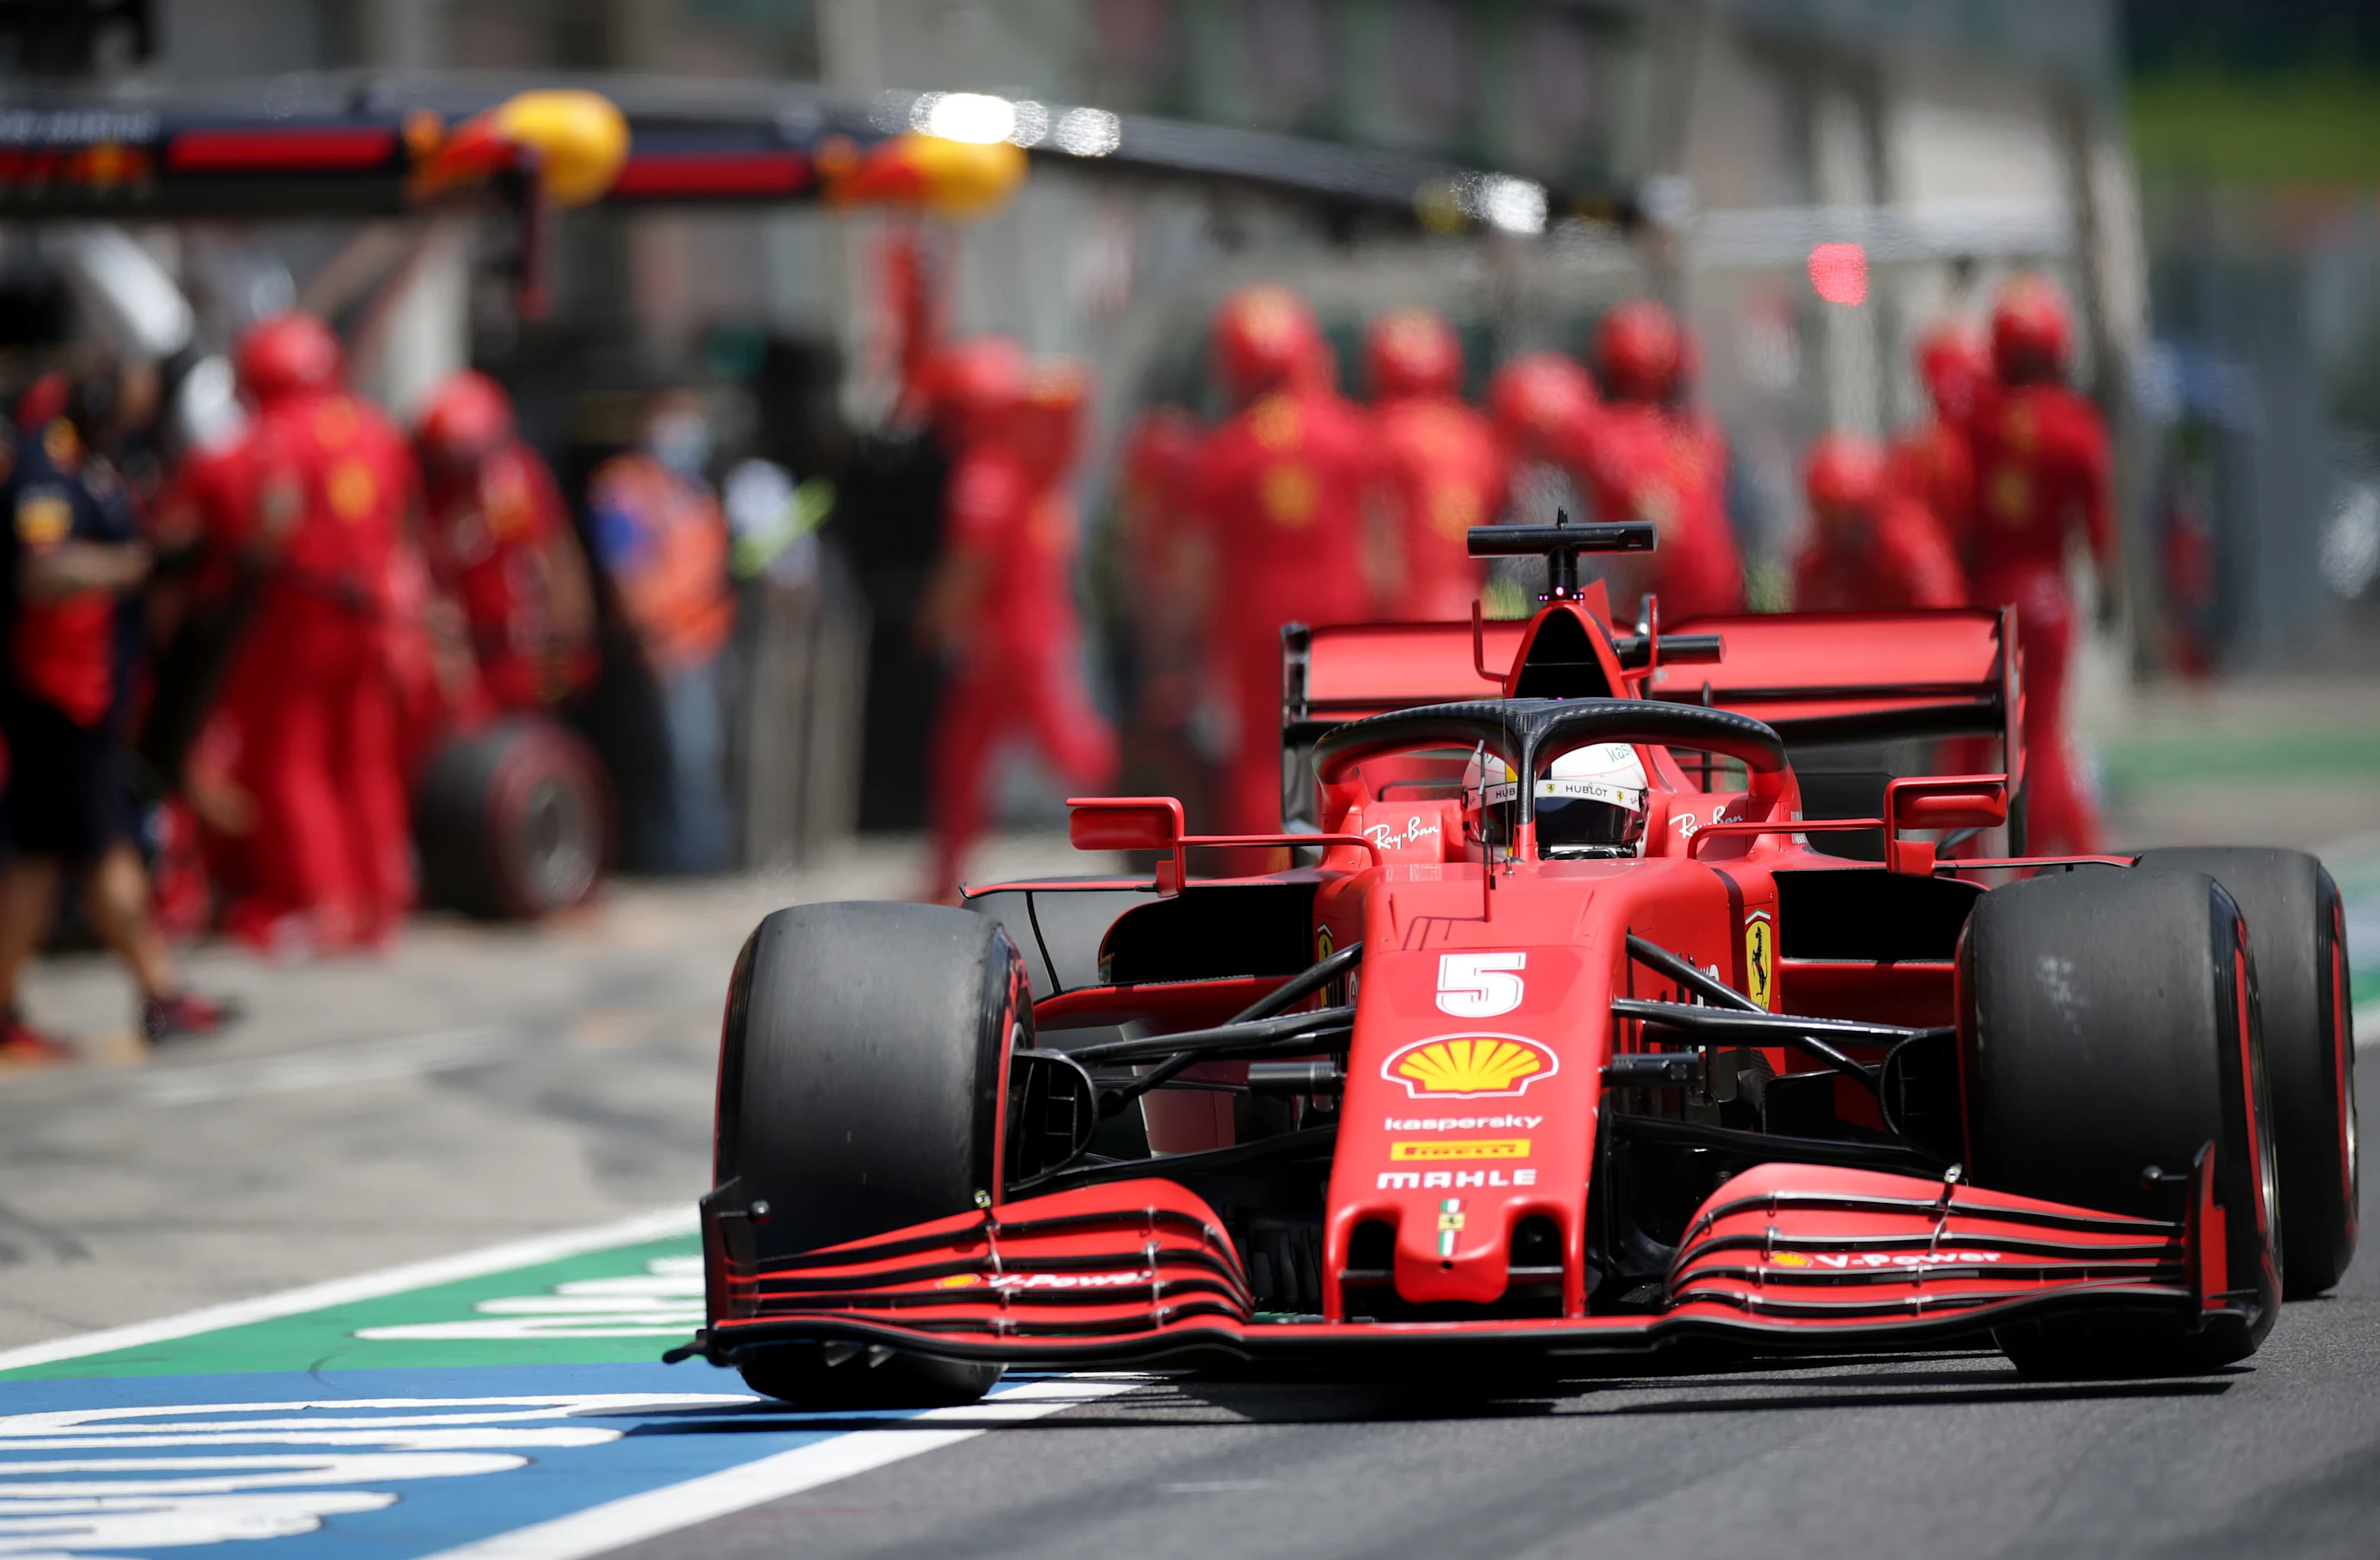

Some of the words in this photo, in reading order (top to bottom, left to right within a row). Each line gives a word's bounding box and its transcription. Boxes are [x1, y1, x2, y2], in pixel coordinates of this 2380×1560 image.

[1565, 784, 1608, 797] HUBLOT
[1363, 816, 1440, 850] Ray-Ban
[1435, 952, 1526, 1017] 5
[1384, 1114, 1544, 1132] kaspersky
[1376, 1168, 1538, 1190] MAHLE
[1815, 1252, 2001, 1269] V-Power
